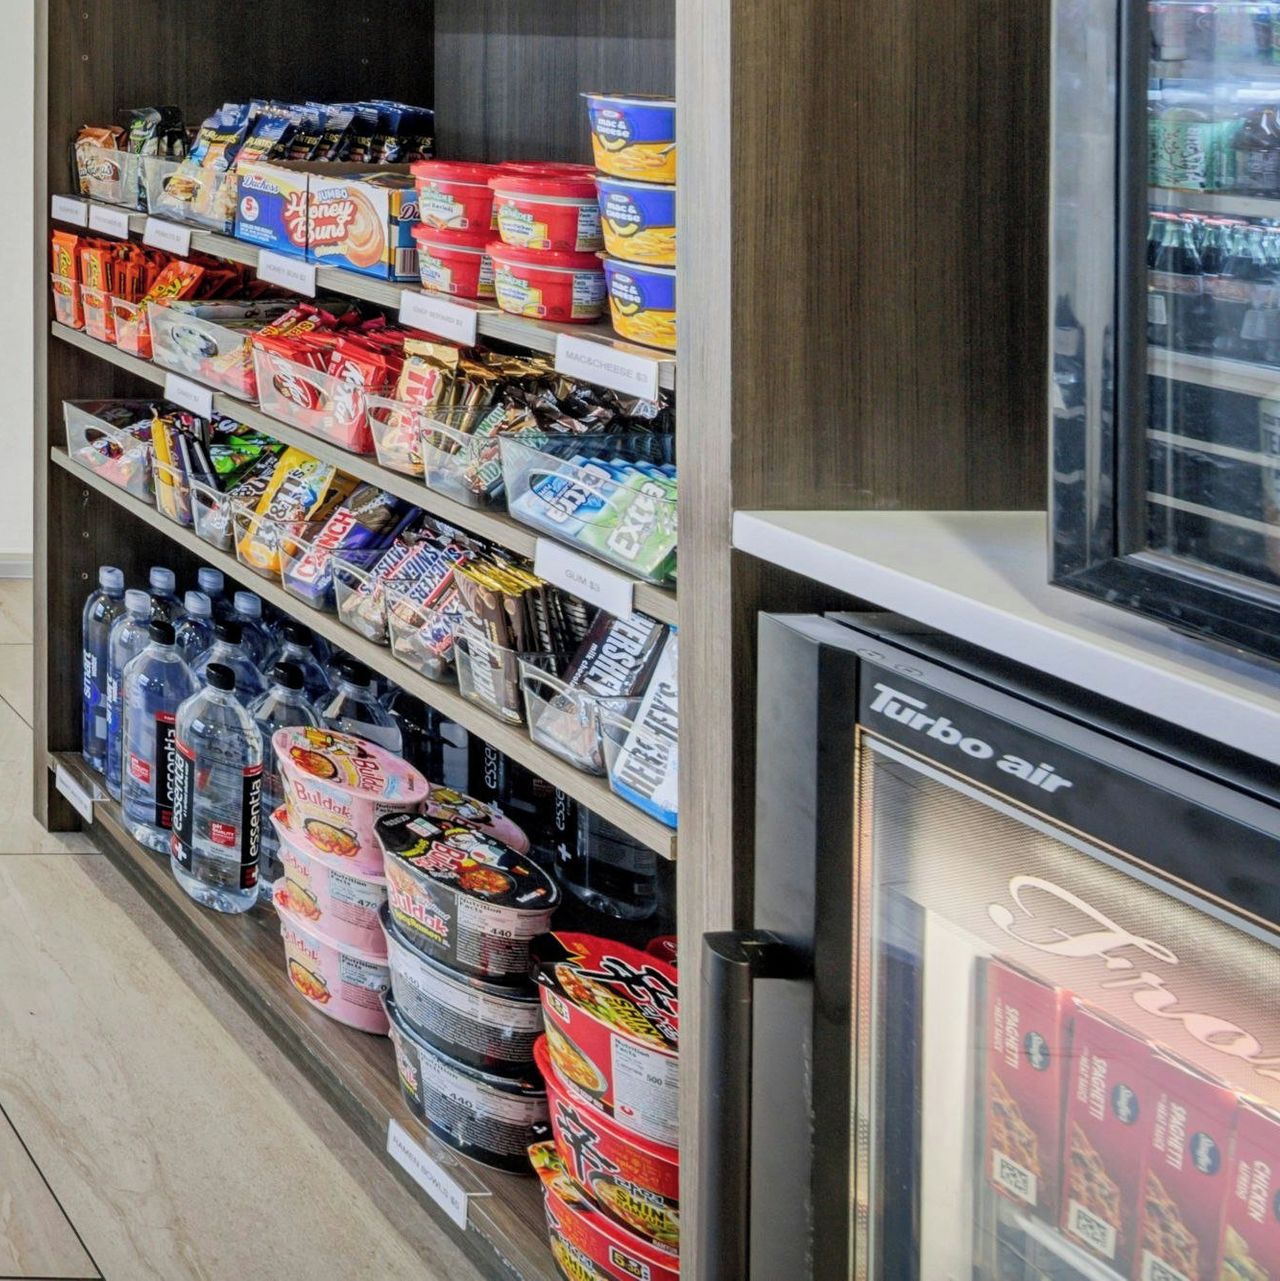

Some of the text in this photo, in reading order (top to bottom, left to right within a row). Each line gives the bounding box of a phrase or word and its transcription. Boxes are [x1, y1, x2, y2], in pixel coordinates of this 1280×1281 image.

[596, 125, 630, 138] cheese
[598, 117, 628, 130] mac &
[241, 175, 280, 194] Duchess
[316, 187, 349, 200] JUMBO
[245, 199, 254, 212] 5
[285, 191, 357, 222] Honey
[606, 201, 638, 213] mac &
[606, 208, 641, 222] cheese
[293, 217, 349, 244] Buns
[564, 349, 650, 384] MAC&CHEESE $3
[409, 546, 462, 605] SNICKERS
[563, 567, 601, 592] GUM $3
[616, 681, 679, 801] HERSHEY'S
[869, 682, 1074, 794] Turbo air
[170, 753, 191, 831] essentia
[294, 780, 352, 819] Buldak
[248, 778, 263, 859] essentia
[330, 870, 368, 888] Nutrition
[330, 876, 352, 887] Facts
[459, 895, 503, 915] Nutrition
[459, 902, 484, 915] Facts
[490, 927, 512, 939] 440
[341, 953, 379, 971] Nutrition
[341, 959, 363, 971] Facts
[988, 875, 1280, 1090] Fro
[1004, 1004, 1021, 1070] SPAGHETTI
[614, 1038, 651, 1058] Nutrition
[614, 1042, 638, 1059] Facts
[645, 1071, 664, 1087] 500
[1088, 1054, 1109, 1122] SPAGHETTI
[449, 1091, 474, 1109] 440
[1165, 1101, 1187, 1171] SPAGHETTI
[392, 1134, 420, 1169] RAMEN
[1247, 1159, 1273, 1225] CHICKEN
[616, 1188, 666, 1223] SHIN
